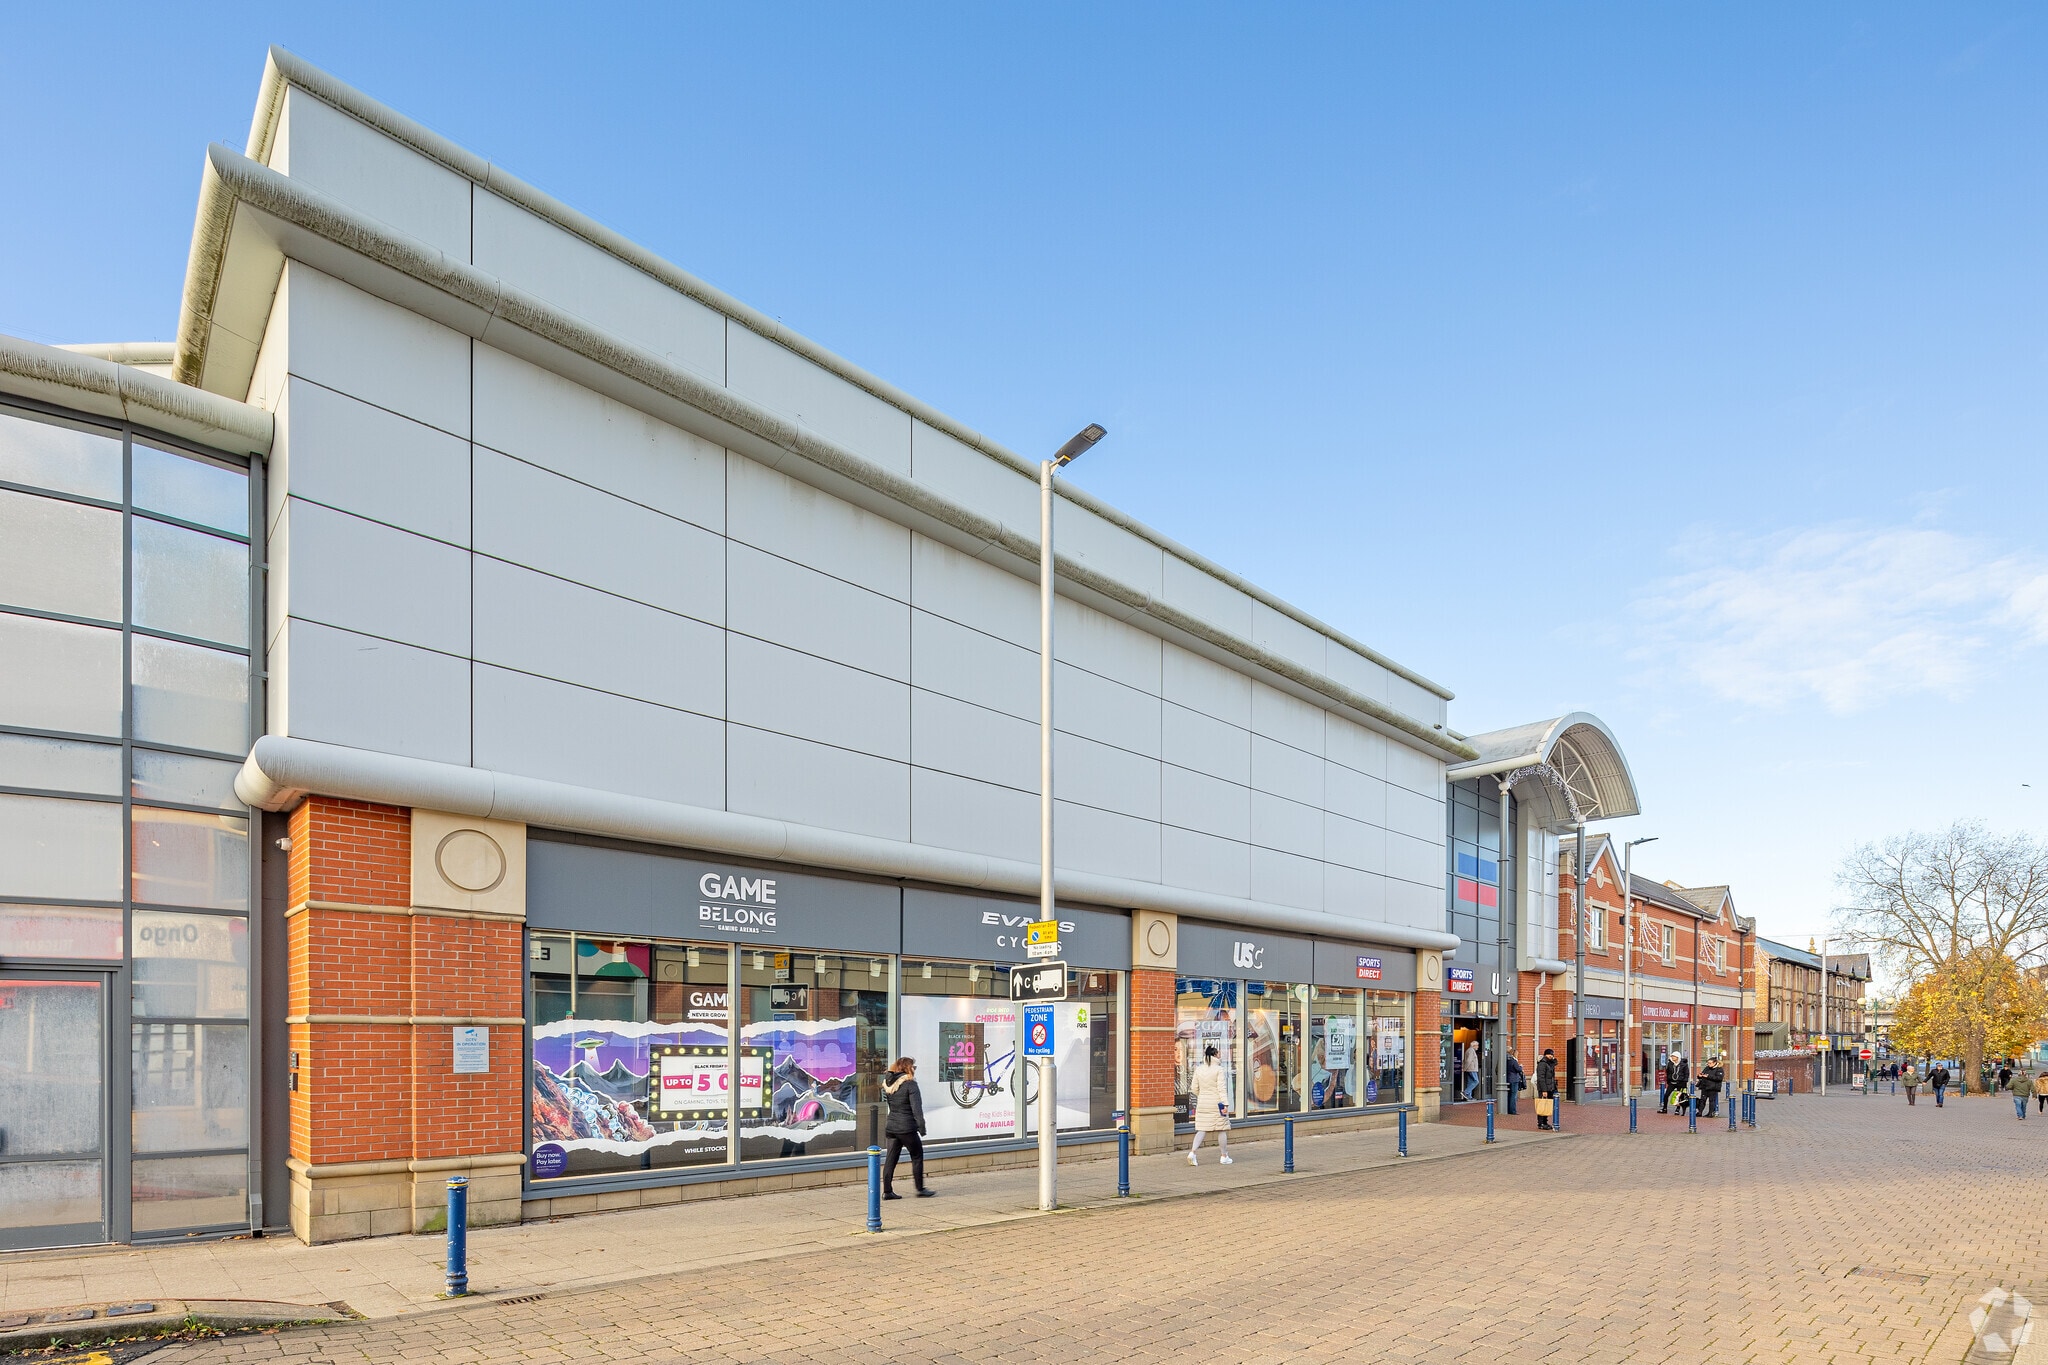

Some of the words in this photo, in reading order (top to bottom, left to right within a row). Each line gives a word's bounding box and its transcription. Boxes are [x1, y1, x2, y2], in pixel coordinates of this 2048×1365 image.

[699, 872, 777, 904] GAME
[699, 905, 777, 927] BELONG
[981, 911, 1076, 933] EVAS
[717, 924, 739, 932] GAMING
[739, 926, 760, 934] ARENAS
[996, 935, 1062, 952] CYCS
[1233, 941, 1264, 970] USC
[1358, 957, 1381, 968] SPORTS
[1358, 968, 1381, 979] DIRECT
[1452, 968, 1473, 980] SPORTS
[1024, 977, 1031, 989] C
[1452, 981, 1473, 992] DIRECT
[1025, 1006, 1053, 1014] PEDESTRIAN
[975, 1014, 1015, 1023] CHRISTMA
[1030, 1013, 1048, 1022] ZONE
[1331, 1034, 1344, 1046] £20
[948, 1041, 975, 1057] £20
[1035, 1047, 1050, 1055] cycling
[665, 1079, 679, 1087] UP
[680, 1078, 692, 1086] TO
[740, 1077, 759, 1086] OFF
[991, 1110, 1002, 1118] Kids
[990, 1120, 1015, 1128] AVAILAB
[536, 1152, 547, 1160] Buy
